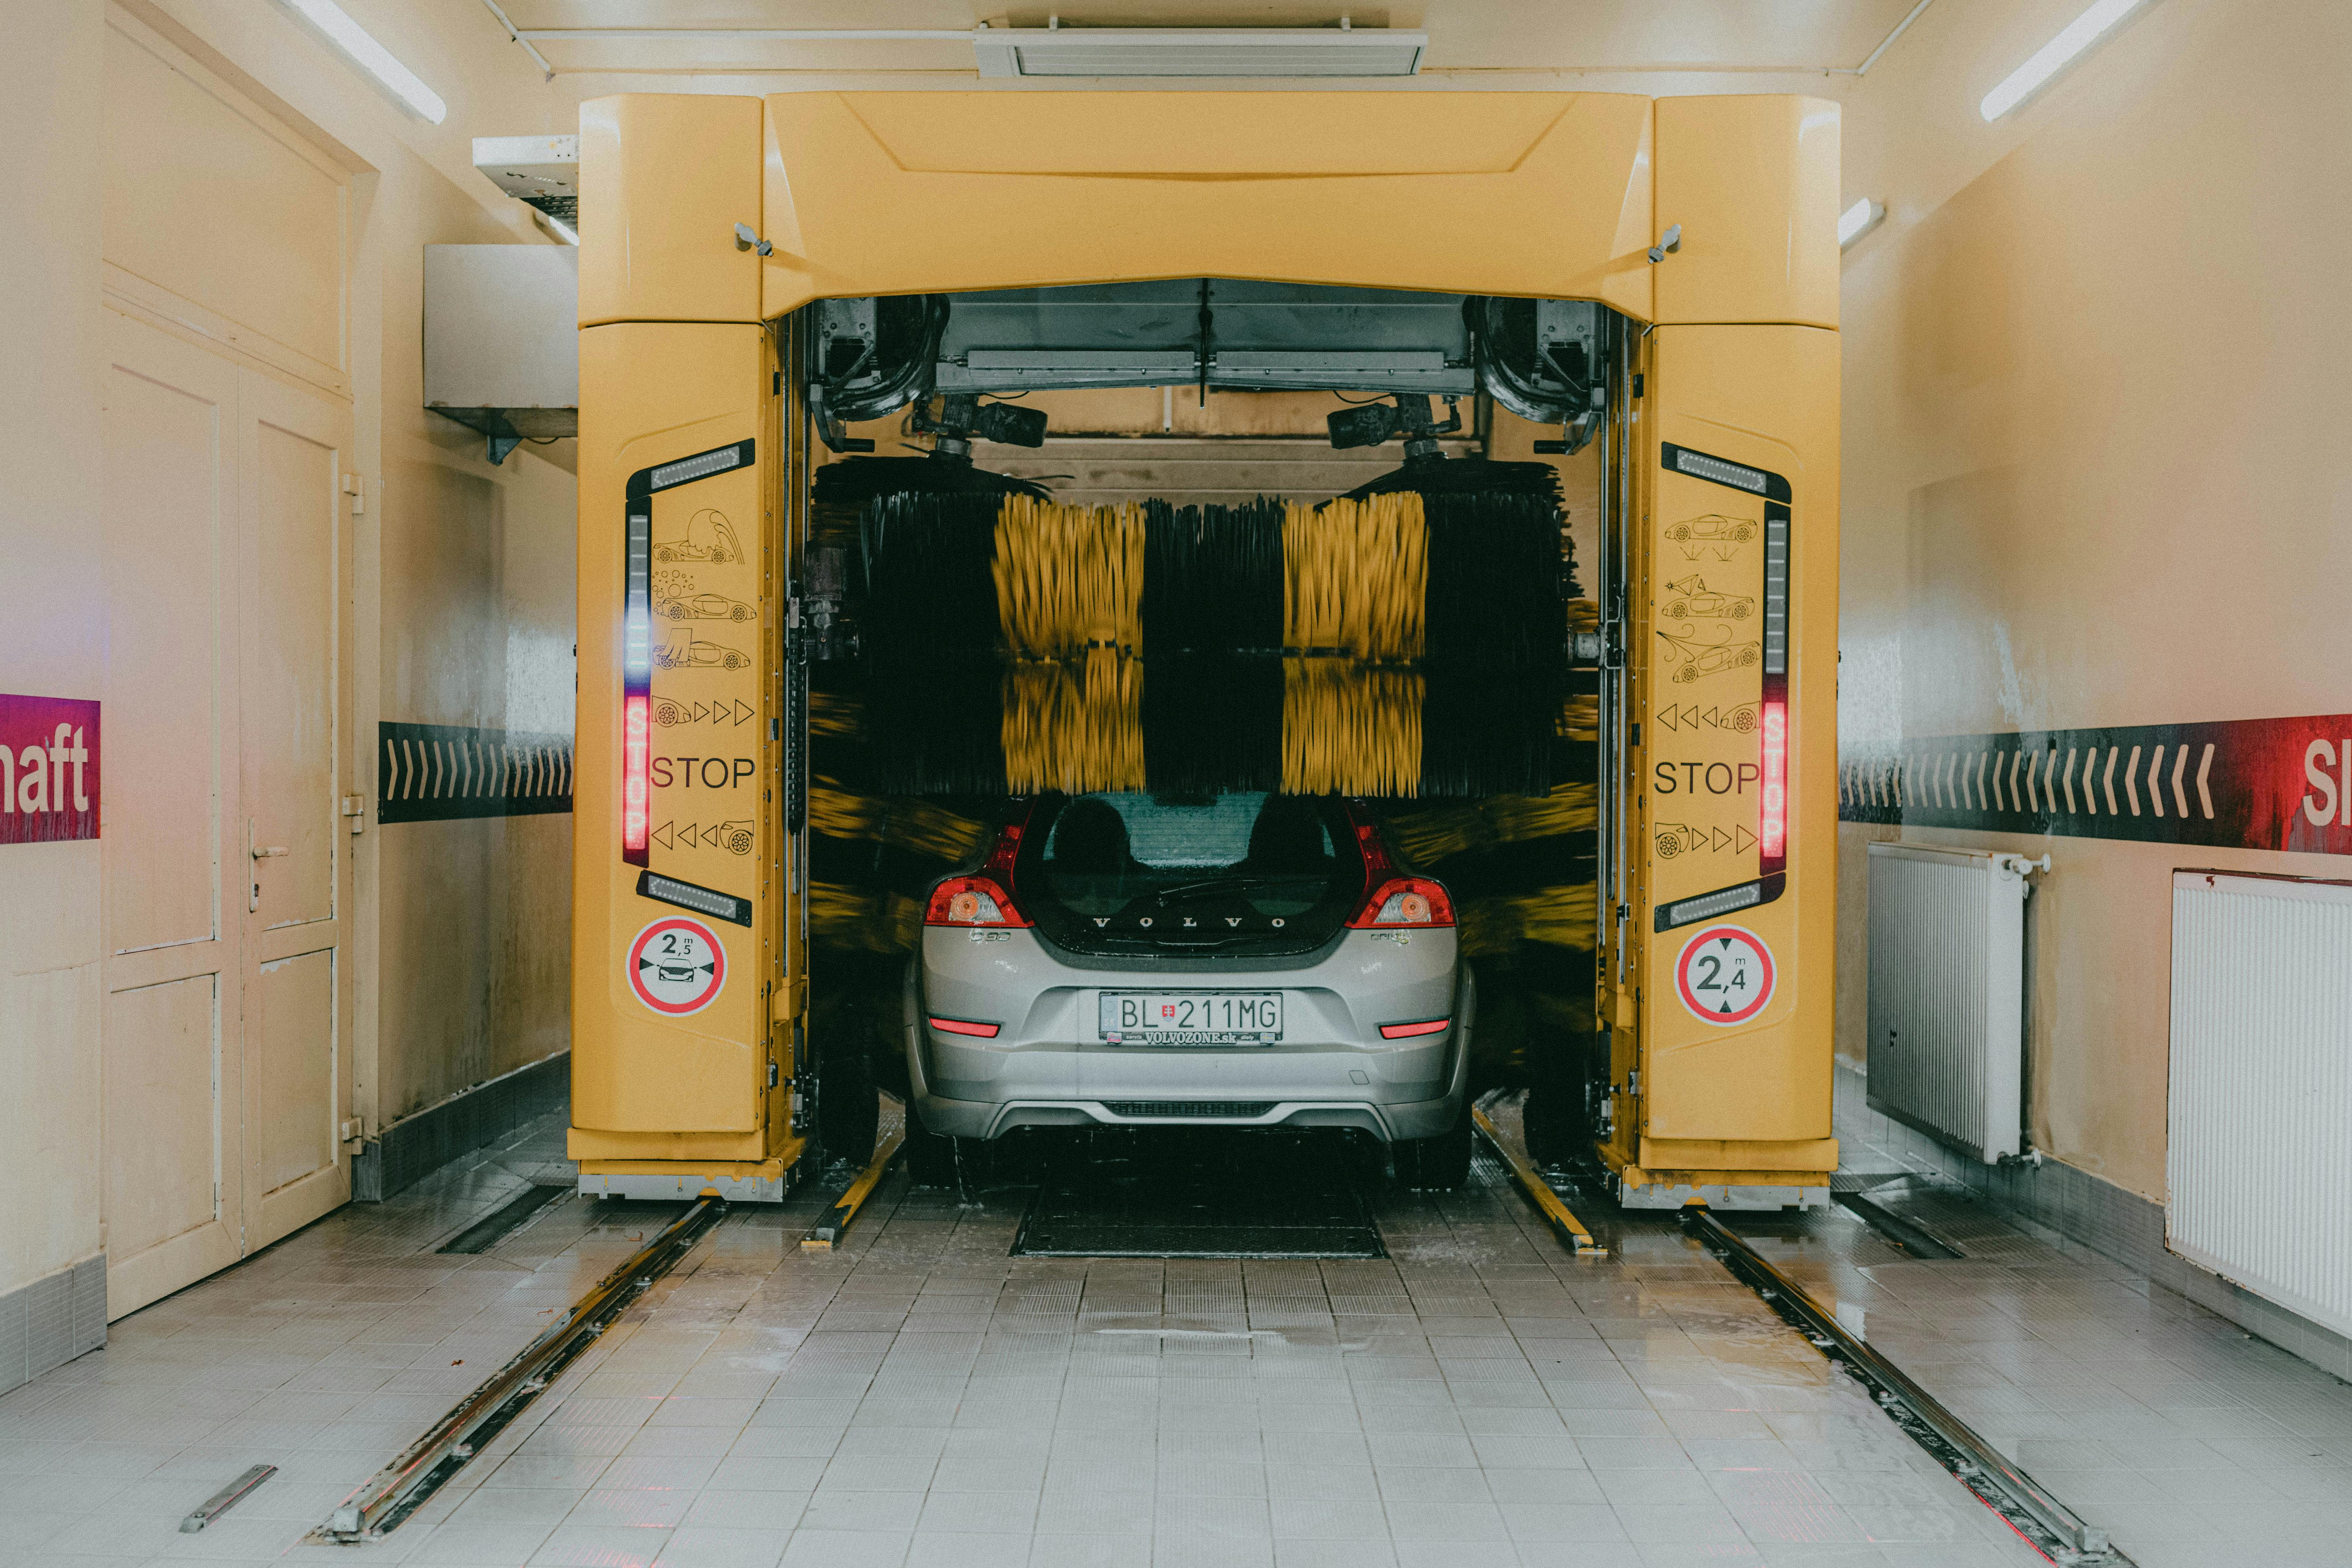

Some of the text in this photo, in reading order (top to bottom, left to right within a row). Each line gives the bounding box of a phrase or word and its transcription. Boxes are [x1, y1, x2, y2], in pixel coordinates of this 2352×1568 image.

[627, 707, 647, 840] STOP
[651, 757, 755, 788] STOP
[1654, 762, 1760, 794] STOP
[1765, 713, 1784, 847] STOP
[1093, 918, 1285, 927] VOLVO
[1103, 1018, 1115, 1026] SK
[1122, 1000, 1275, 1028] BL 211MG
[1145, 1032, 1237, 1044] VOLVOZONE.sk
